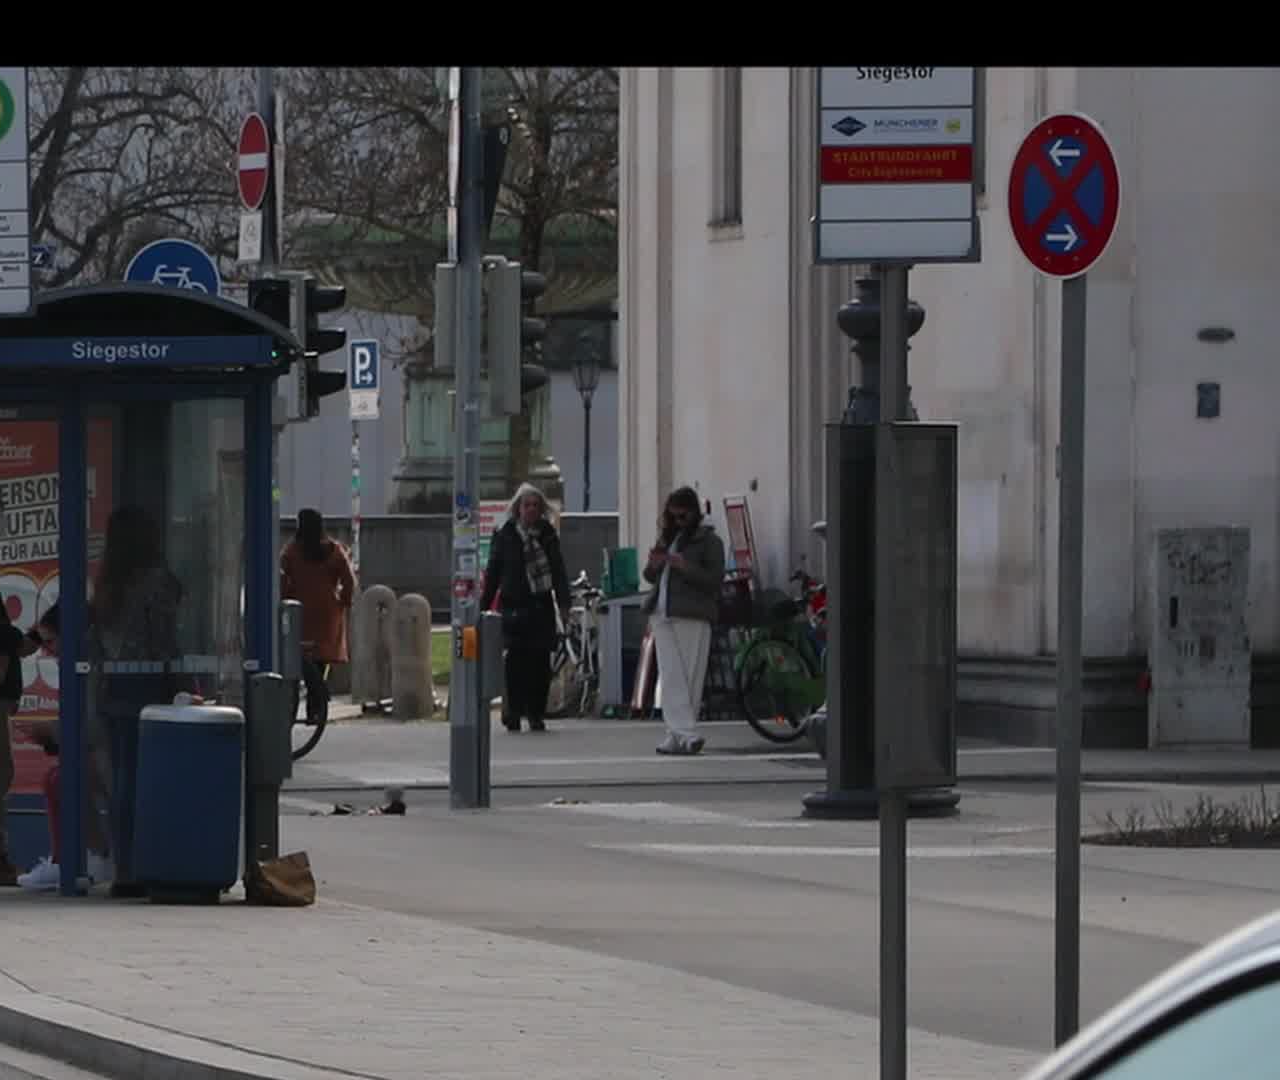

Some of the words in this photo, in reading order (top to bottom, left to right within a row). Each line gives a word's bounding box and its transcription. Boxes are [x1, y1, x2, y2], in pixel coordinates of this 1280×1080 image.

[856, 67, 935, 83] Siegestor
[72, 341, 169, 362] Siegestor
[355, 347, 371, 385] P
[0, 478, 57, 505] ERSO
[7, 509, 57, 535] UFTA
[32, 539, 57, 558] ALL
